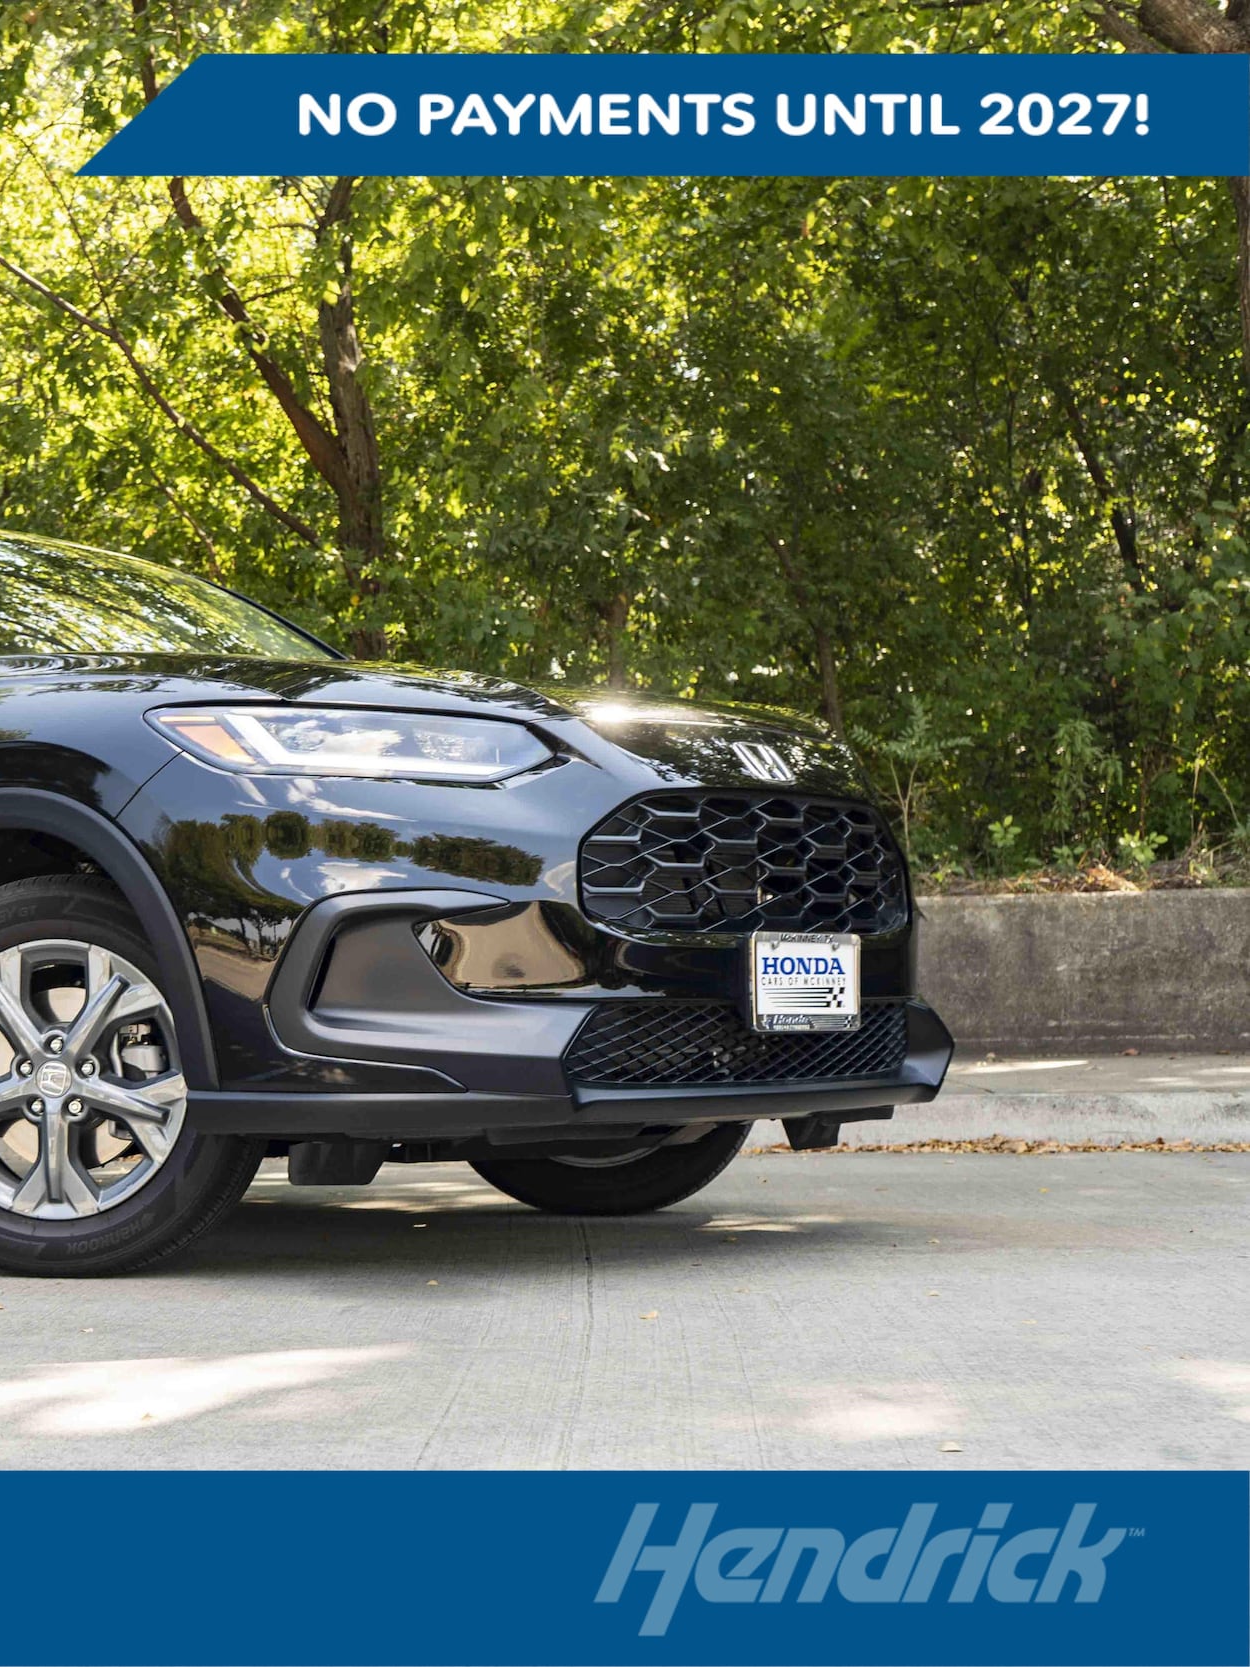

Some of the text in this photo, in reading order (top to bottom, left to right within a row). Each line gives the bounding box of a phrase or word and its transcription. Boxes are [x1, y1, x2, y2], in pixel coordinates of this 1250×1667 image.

[761, 957, 846, 975] HONDA
[761, 977, 783, 986] CARS
[789, 977, 799, 986] OF
